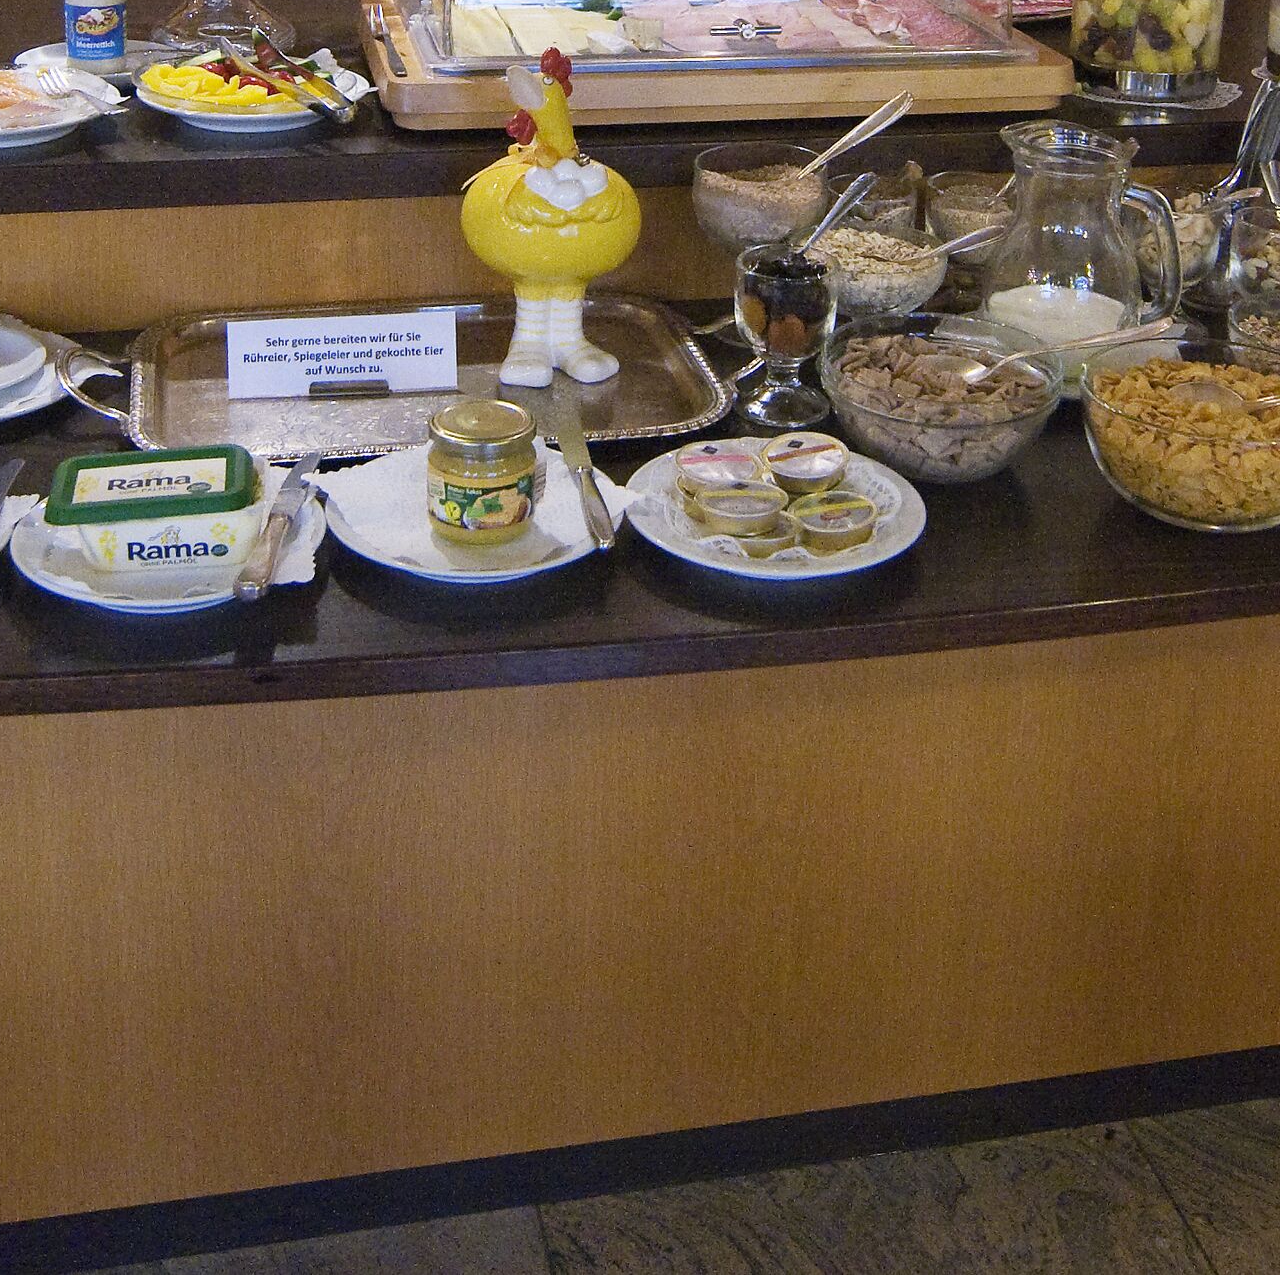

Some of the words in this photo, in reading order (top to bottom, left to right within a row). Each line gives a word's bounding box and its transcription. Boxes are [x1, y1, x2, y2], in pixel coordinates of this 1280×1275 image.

[266, 336, 289, 347] Sehr
[291, 338, 321, 349] gerne
[323, 334, 367, 345] bereiten
[369, 333, 385, 343] wir
[388, 332, 404, 343] für
[406, 331, 421, 342] Sie
[243, 351, 291, 364] Rühreier,
[293, 349, 350, 363] Spiegeleier
[353, 348, 373, 359] und
[375, 347, 422, 360] gekochte
[424, 345, 444, 356] Eier
[305, 364, 323, 376] auf
[324, 363, 366, 375] Wunsch
[369, 365, 383, 374] zu.
[107, 474, 191, 491] Rama
[127, 541, 210, 562] Rama
